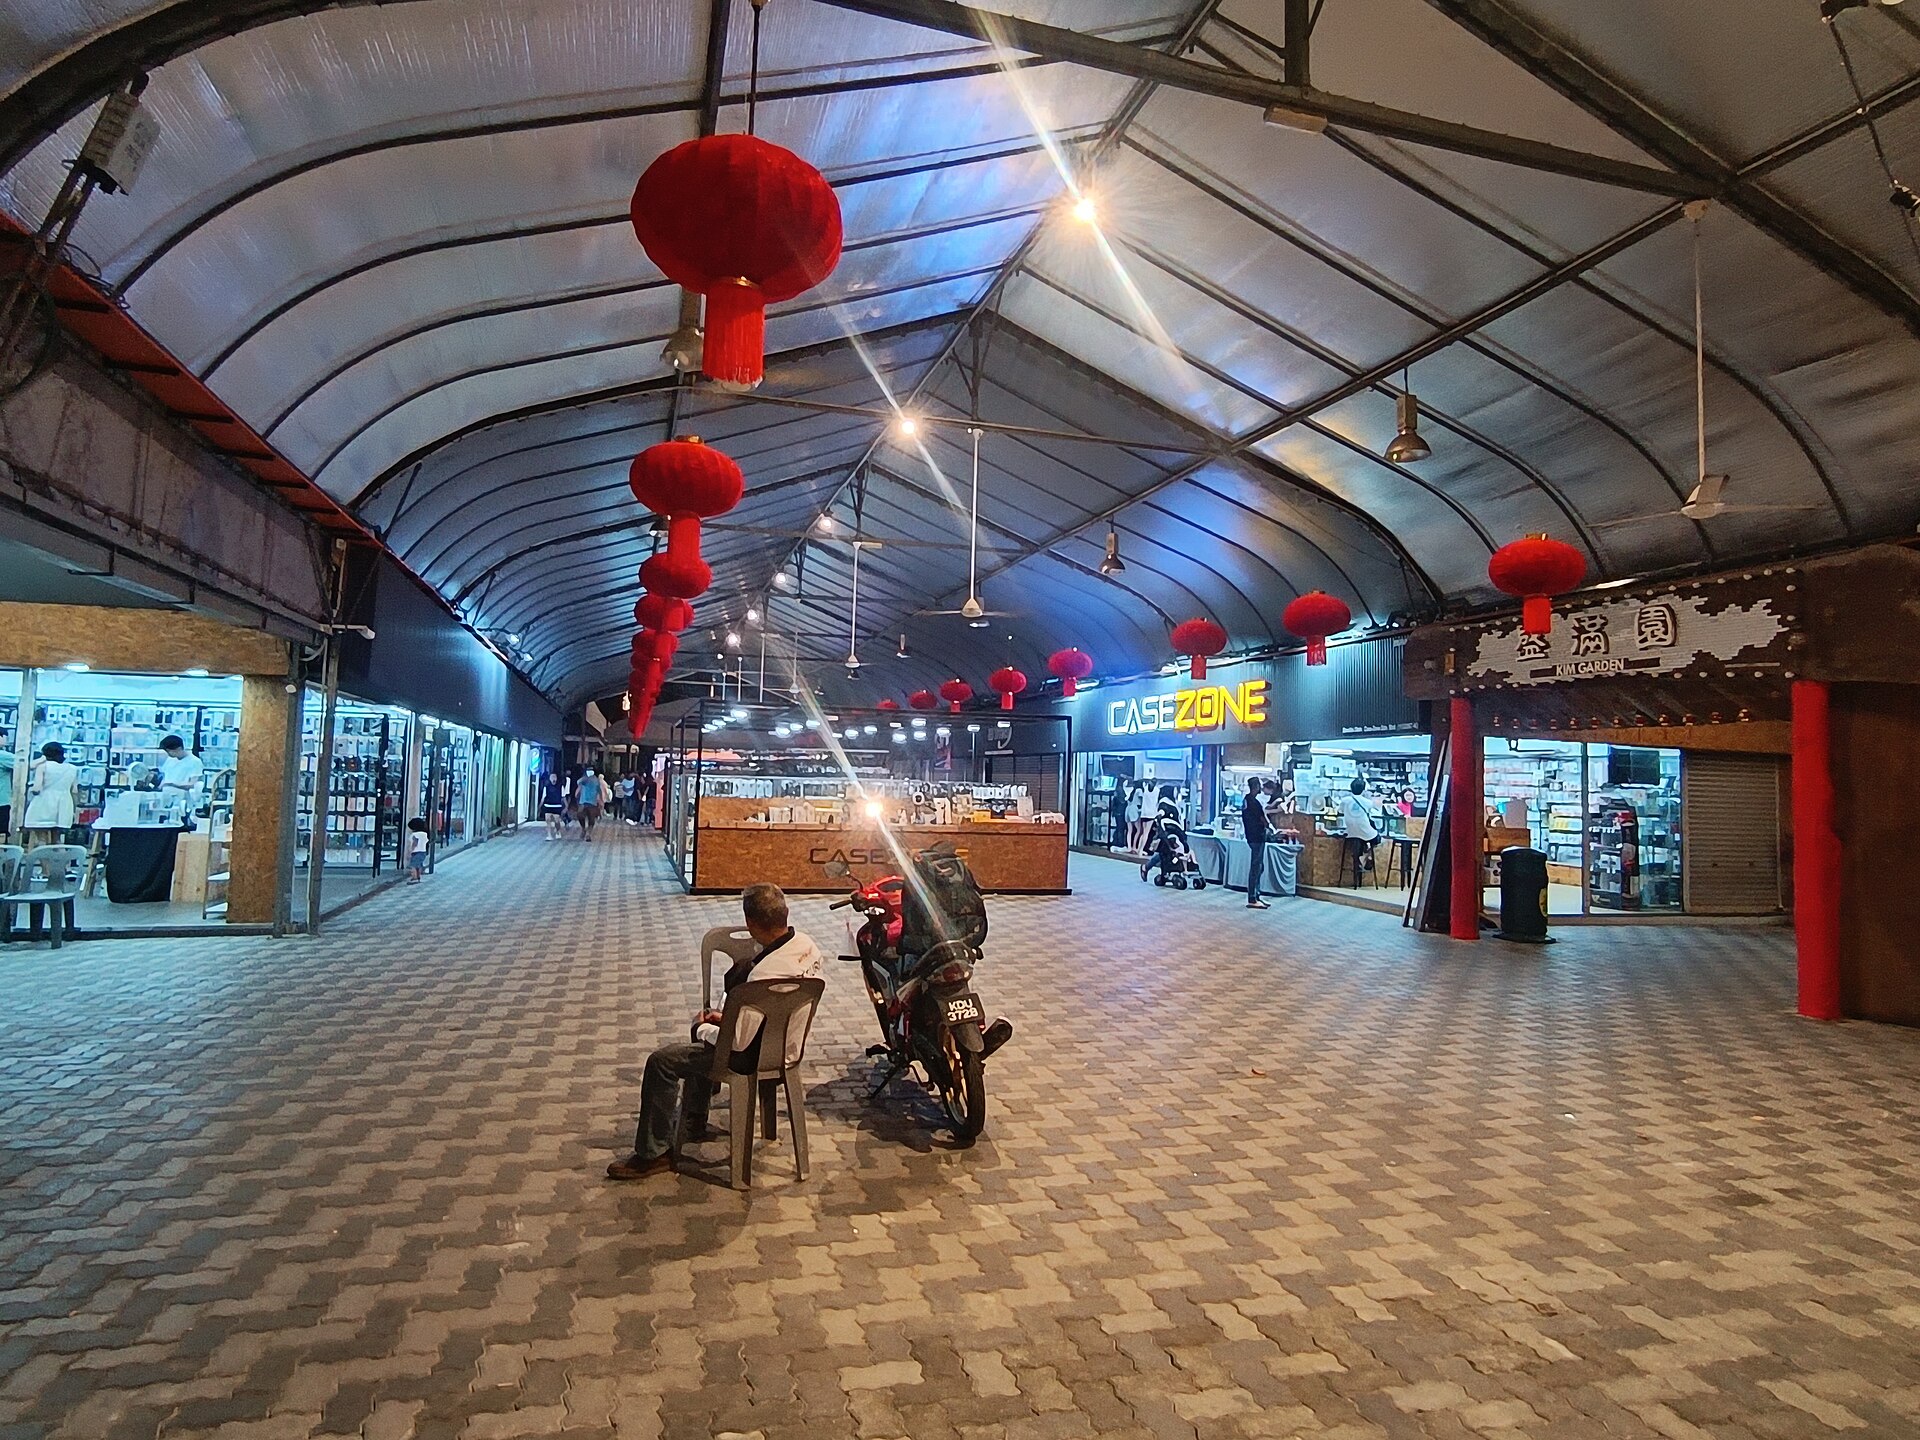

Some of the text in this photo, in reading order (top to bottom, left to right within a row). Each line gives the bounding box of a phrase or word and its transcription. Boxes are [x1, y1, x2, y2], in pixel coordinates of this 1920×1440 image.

[1556, 659, 1625, 677] KIM GARDEN
[1108, 680, 1267, 736] CASEZONE
[948, 998, 973, 1011] KDU
[947, 1007, 979, 1021] 3728
